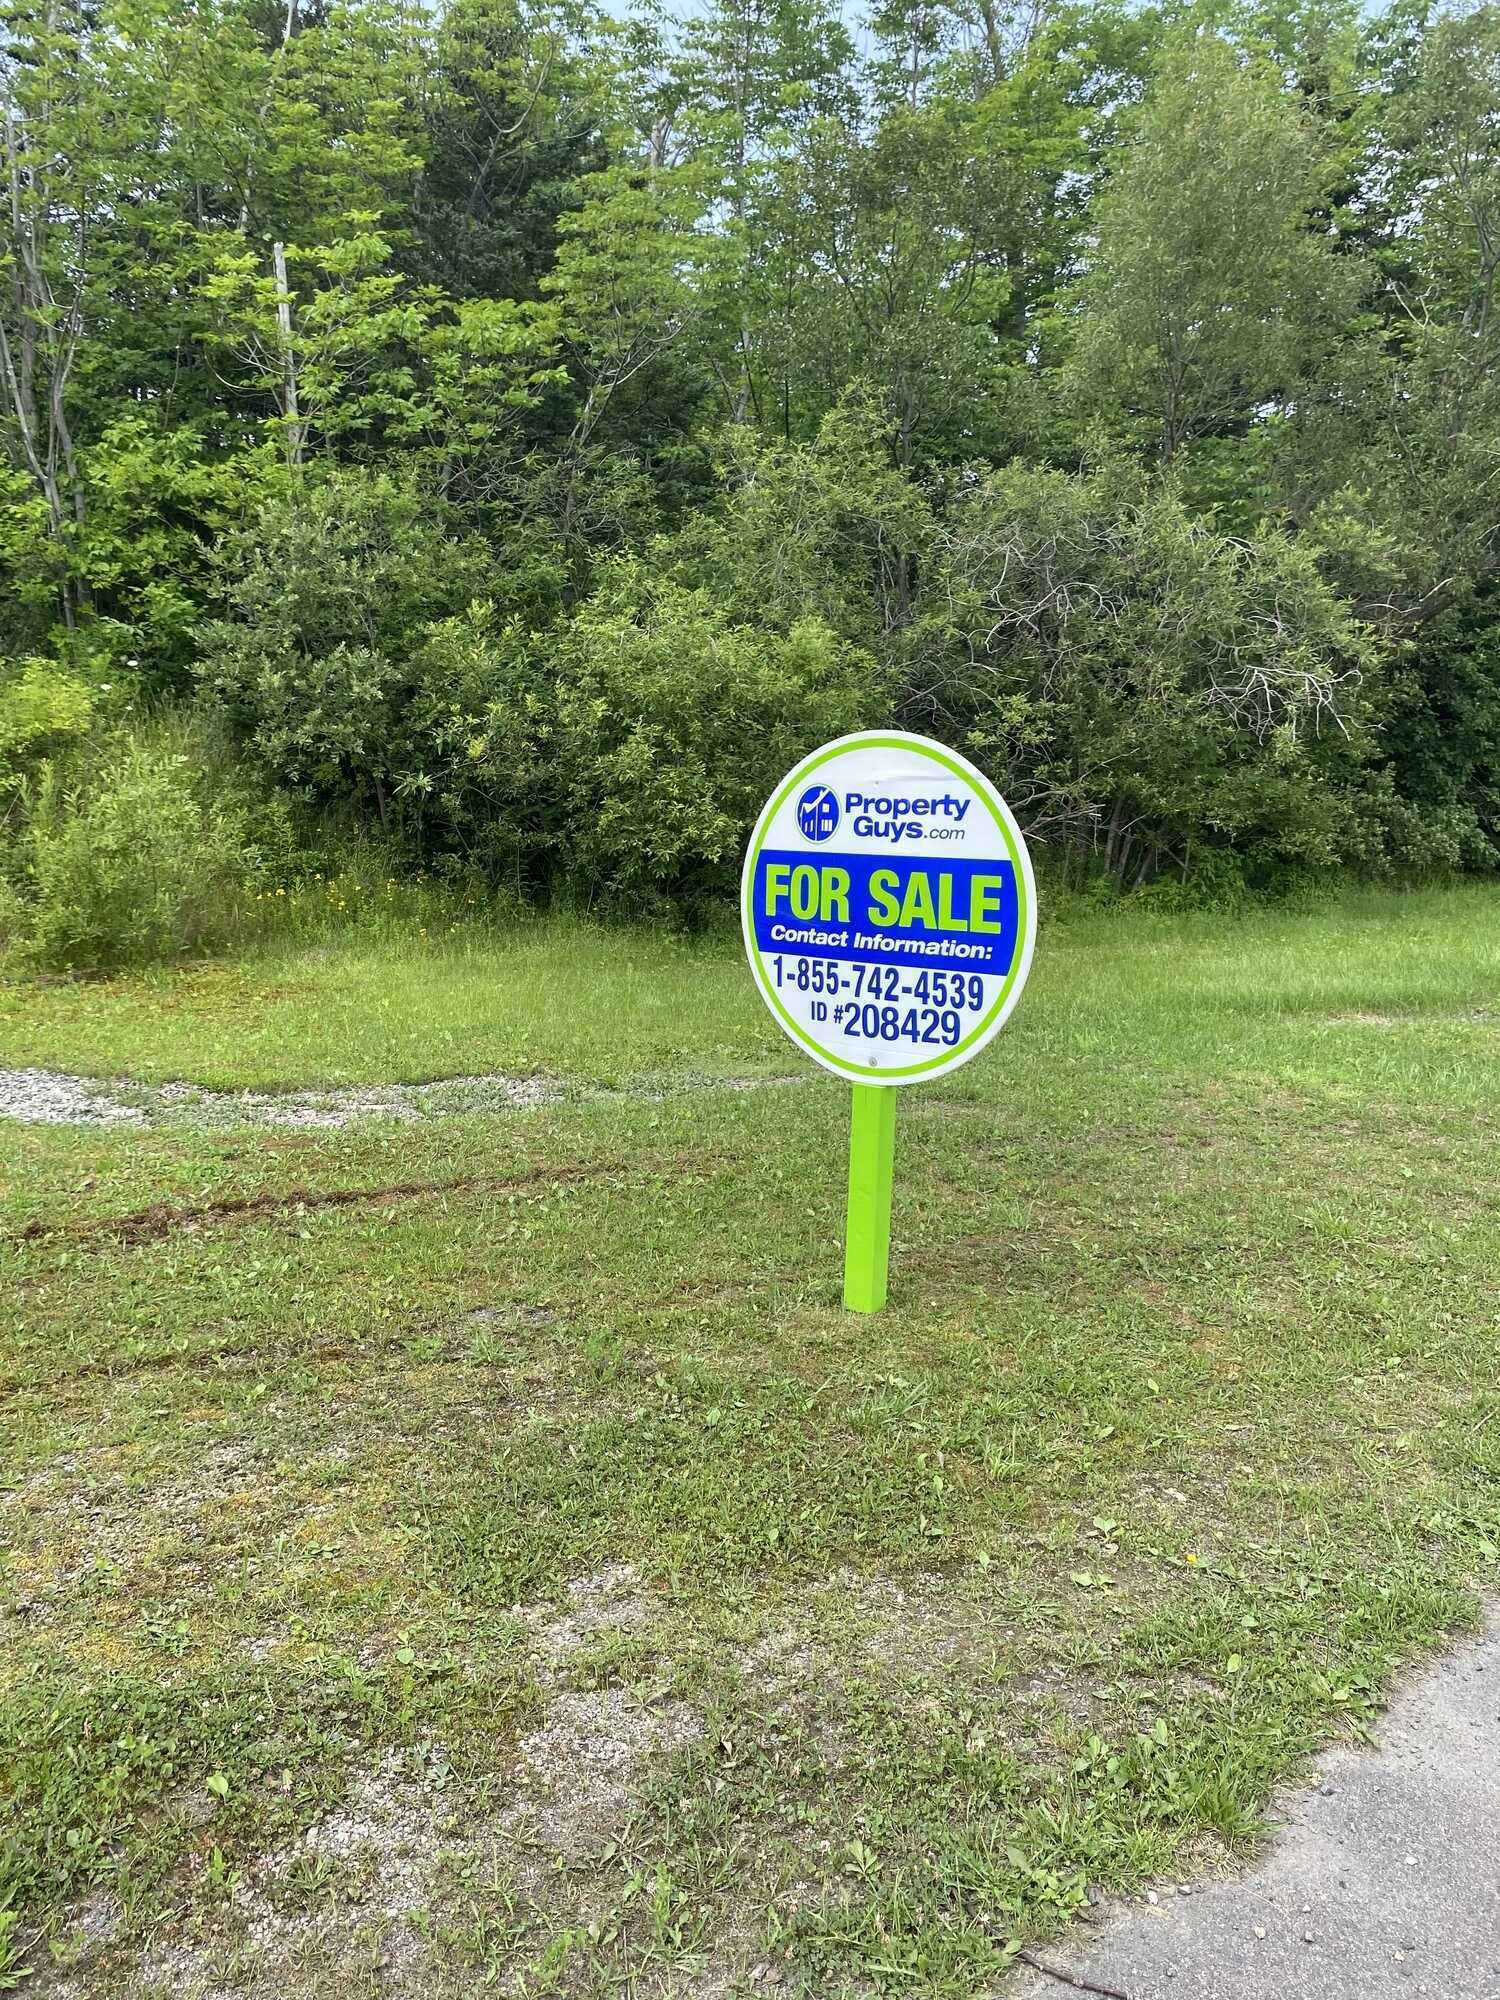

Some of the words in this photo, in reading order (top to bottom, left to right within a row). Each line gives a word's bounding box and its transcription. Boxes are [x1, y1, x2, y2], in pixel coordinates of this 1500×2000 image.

[845, 793, 971, 822] Property
[853, 816, 966, 843] Guys.com
[765, 863, 850, 923] FOR
[868, 869, 1002, 935] SALE
[770, 925, 849, 947] Contact
[853, 932, 993, 960] Information:
[773, 955, 984, 1011] 1-855-742-4539
[811, 1001, 827, 1022] ID
[833, 1003, 961, 1046] #208429
